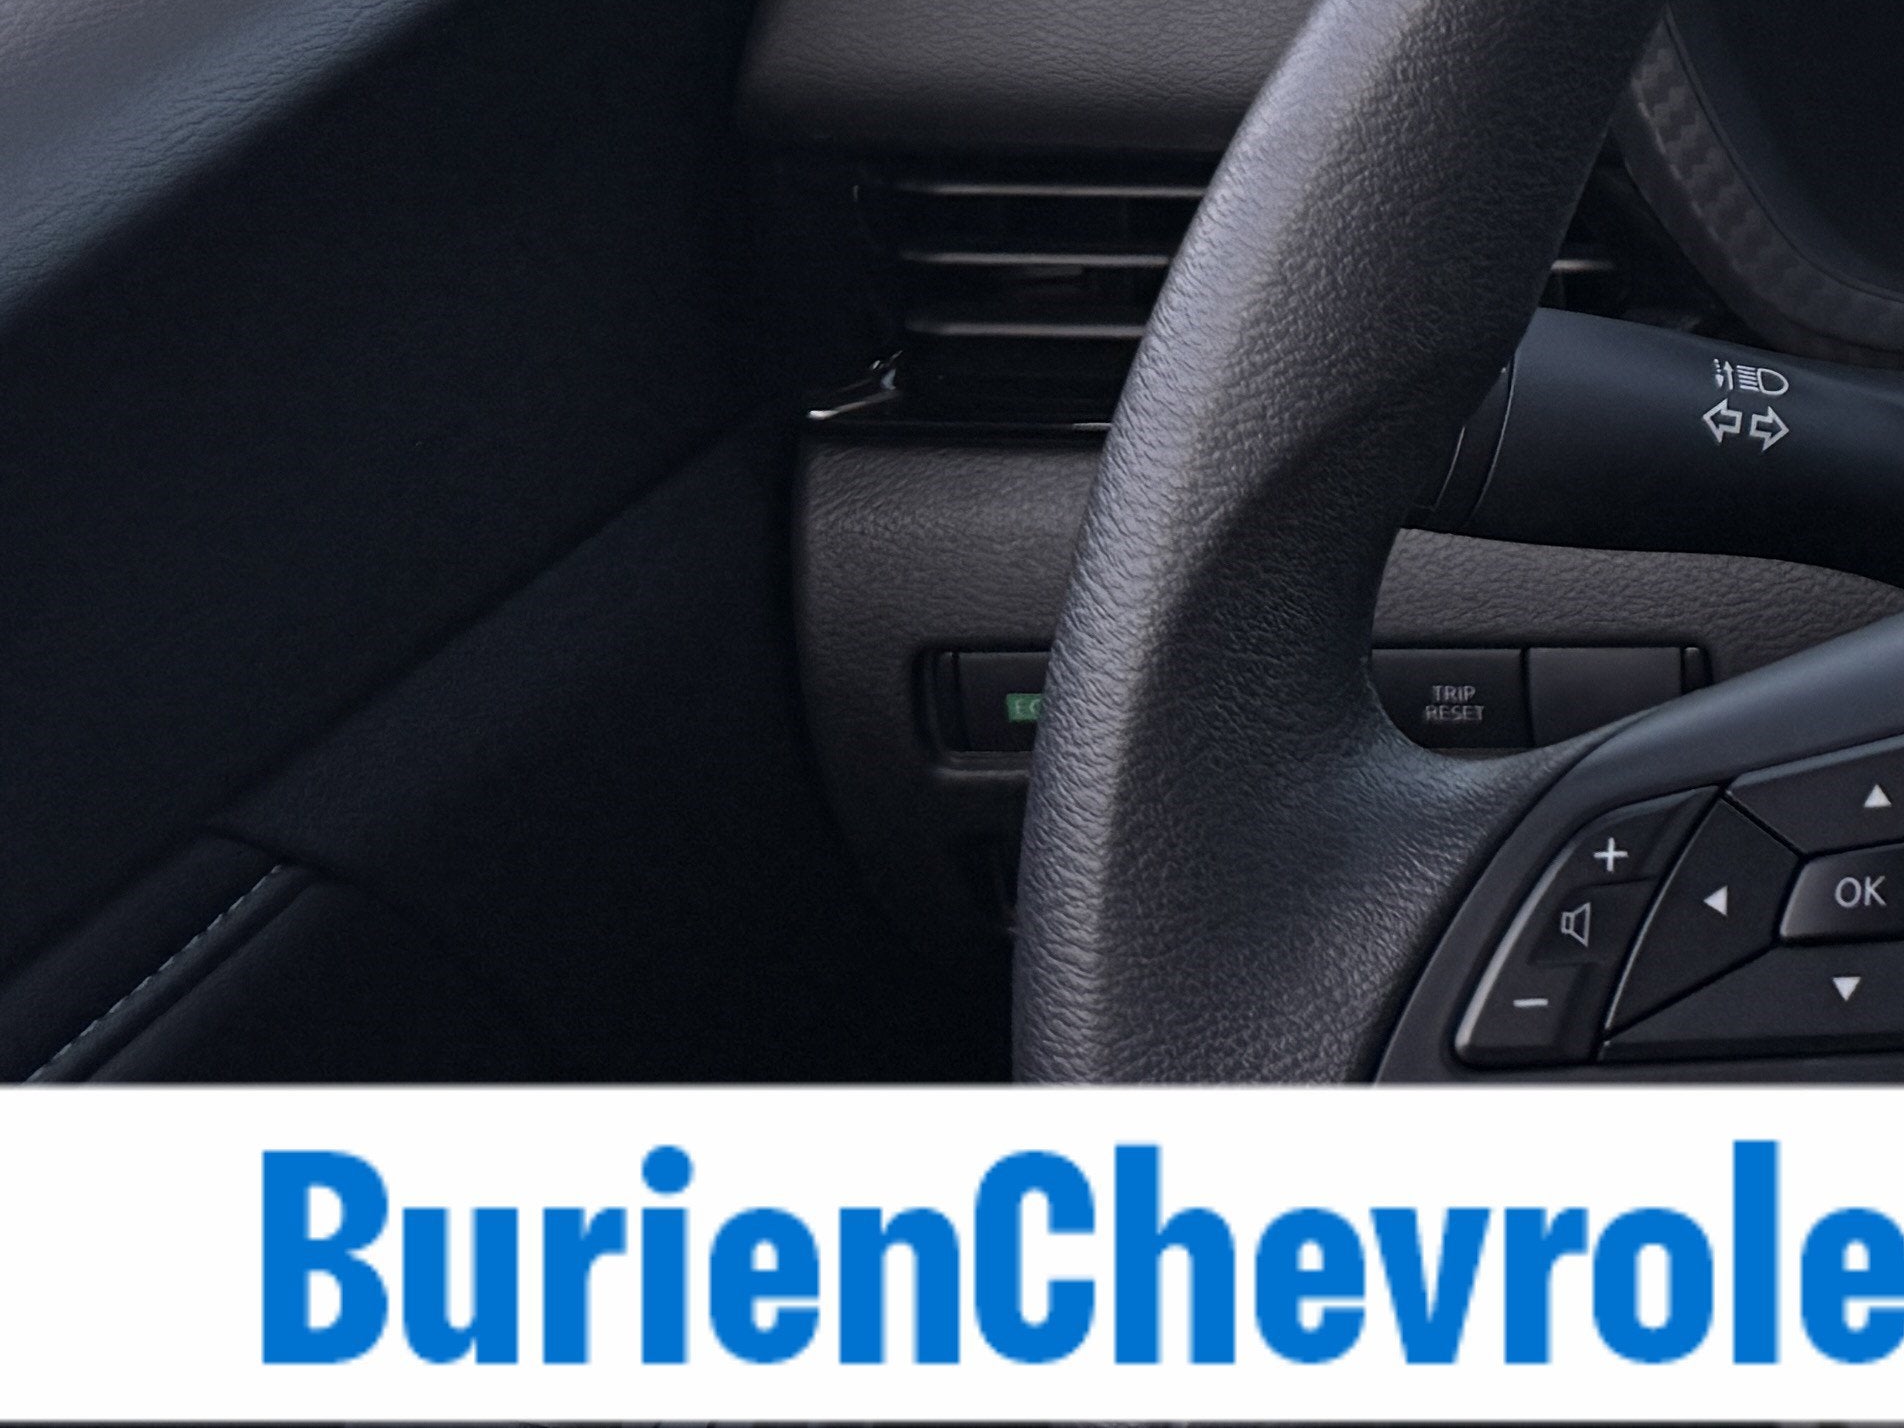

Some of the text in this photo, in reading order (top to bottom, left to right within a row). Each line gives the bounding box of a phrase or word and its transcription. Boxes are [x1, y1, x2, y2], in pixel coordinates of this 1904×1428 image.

[1432, 685, 1476, 702] TRIP
[1425, 704, 1484, 724] RESET
[1834, 875, 1887, 908] OK
